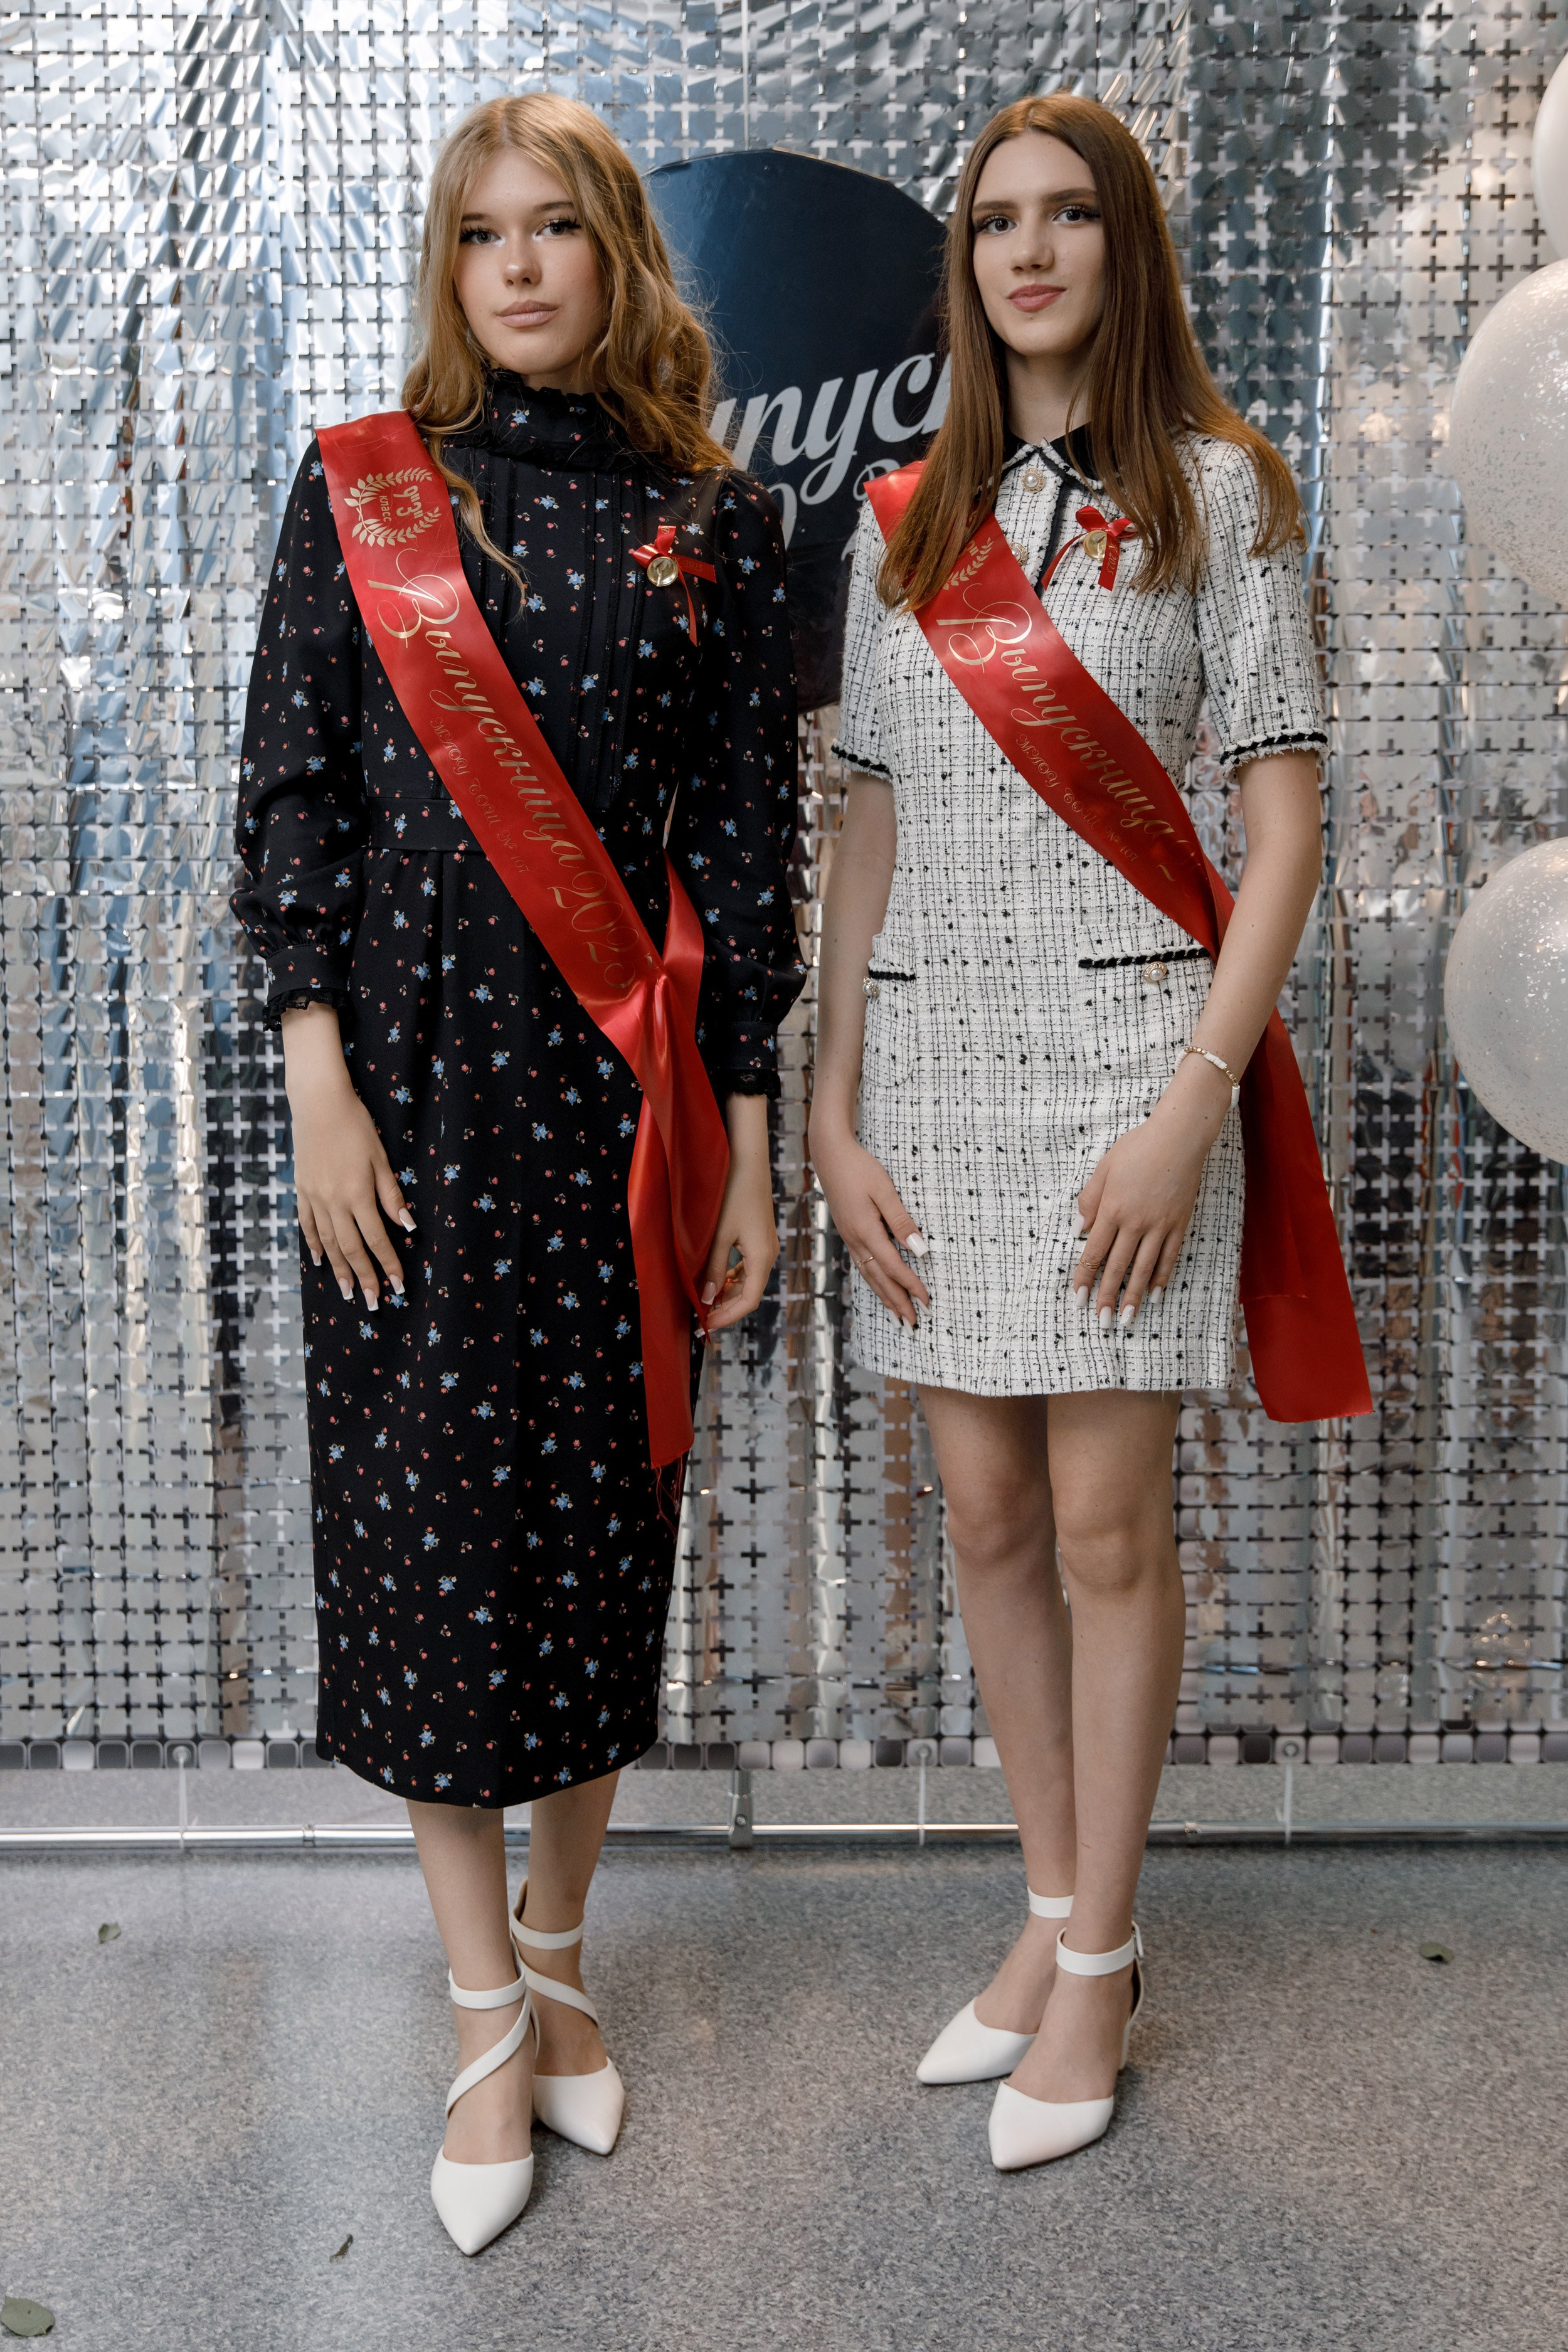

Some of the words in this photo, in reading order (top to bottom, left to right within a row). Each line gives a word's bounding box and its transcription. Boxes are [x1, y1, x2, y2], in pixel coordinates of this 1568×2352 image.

[379, 495, 392, 522] класс
[368, 548, 585, 869] Выпускница
[936, 583, 1175, 842] Выпускница
[511, 856, 531, 874] 107
[1120, 846, 1139, 862] 107
